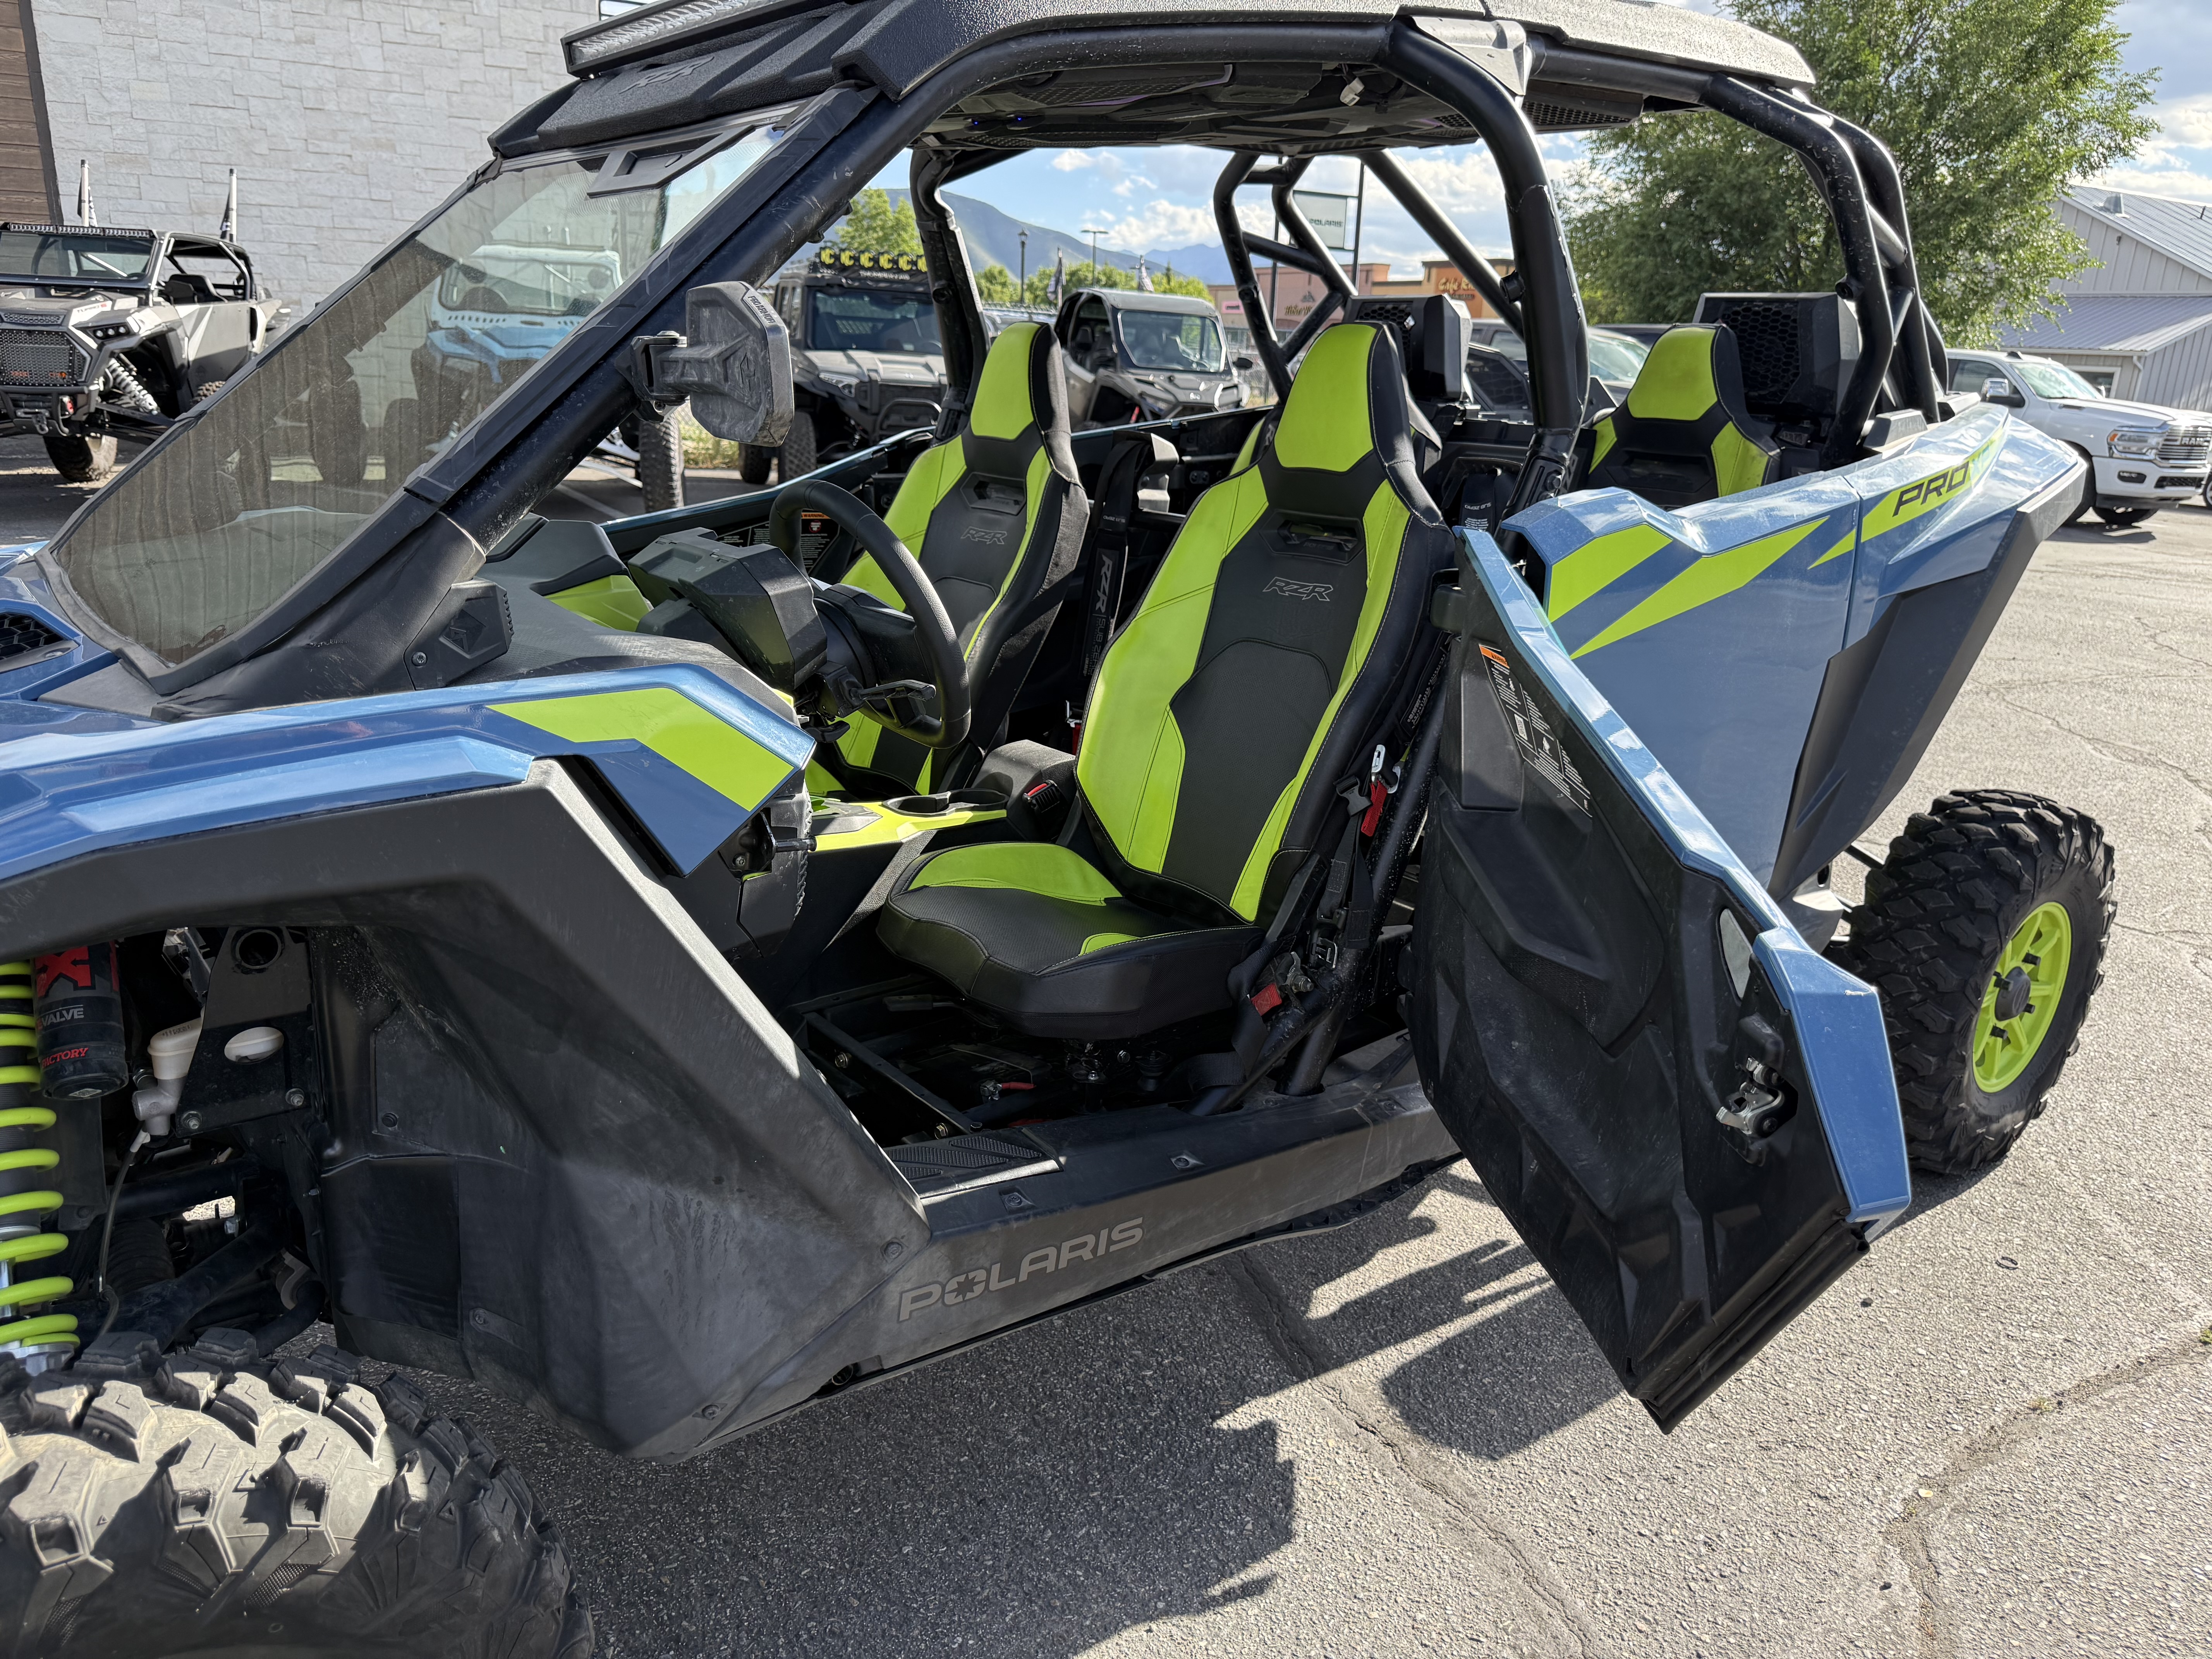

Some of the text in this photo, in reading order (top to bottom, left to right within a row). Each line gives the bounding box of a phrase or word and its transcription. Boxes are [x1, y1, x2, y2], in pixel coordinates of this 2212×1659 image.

[821, 248, 835, 264] KC
[840, 250, 854, 266] KC
[860, 252, 874, 268] KC
[879, 253, 893, 270] KC
[898, 255, 912, 271] KC
[755, 305, 776, 323] ARMOR
[1892, 460, 1970, 517] PRO
[960, 526, 1007, 544] RZR
[1095, 554, 1113, 613] RZR
[1262, 576, 1333, 601] RZR
[1097, 619, 1106, 642] SUB
[41, 1048, 89, 1069] FACTORY
[898, 1217, 1143, 1321] POLARIS
